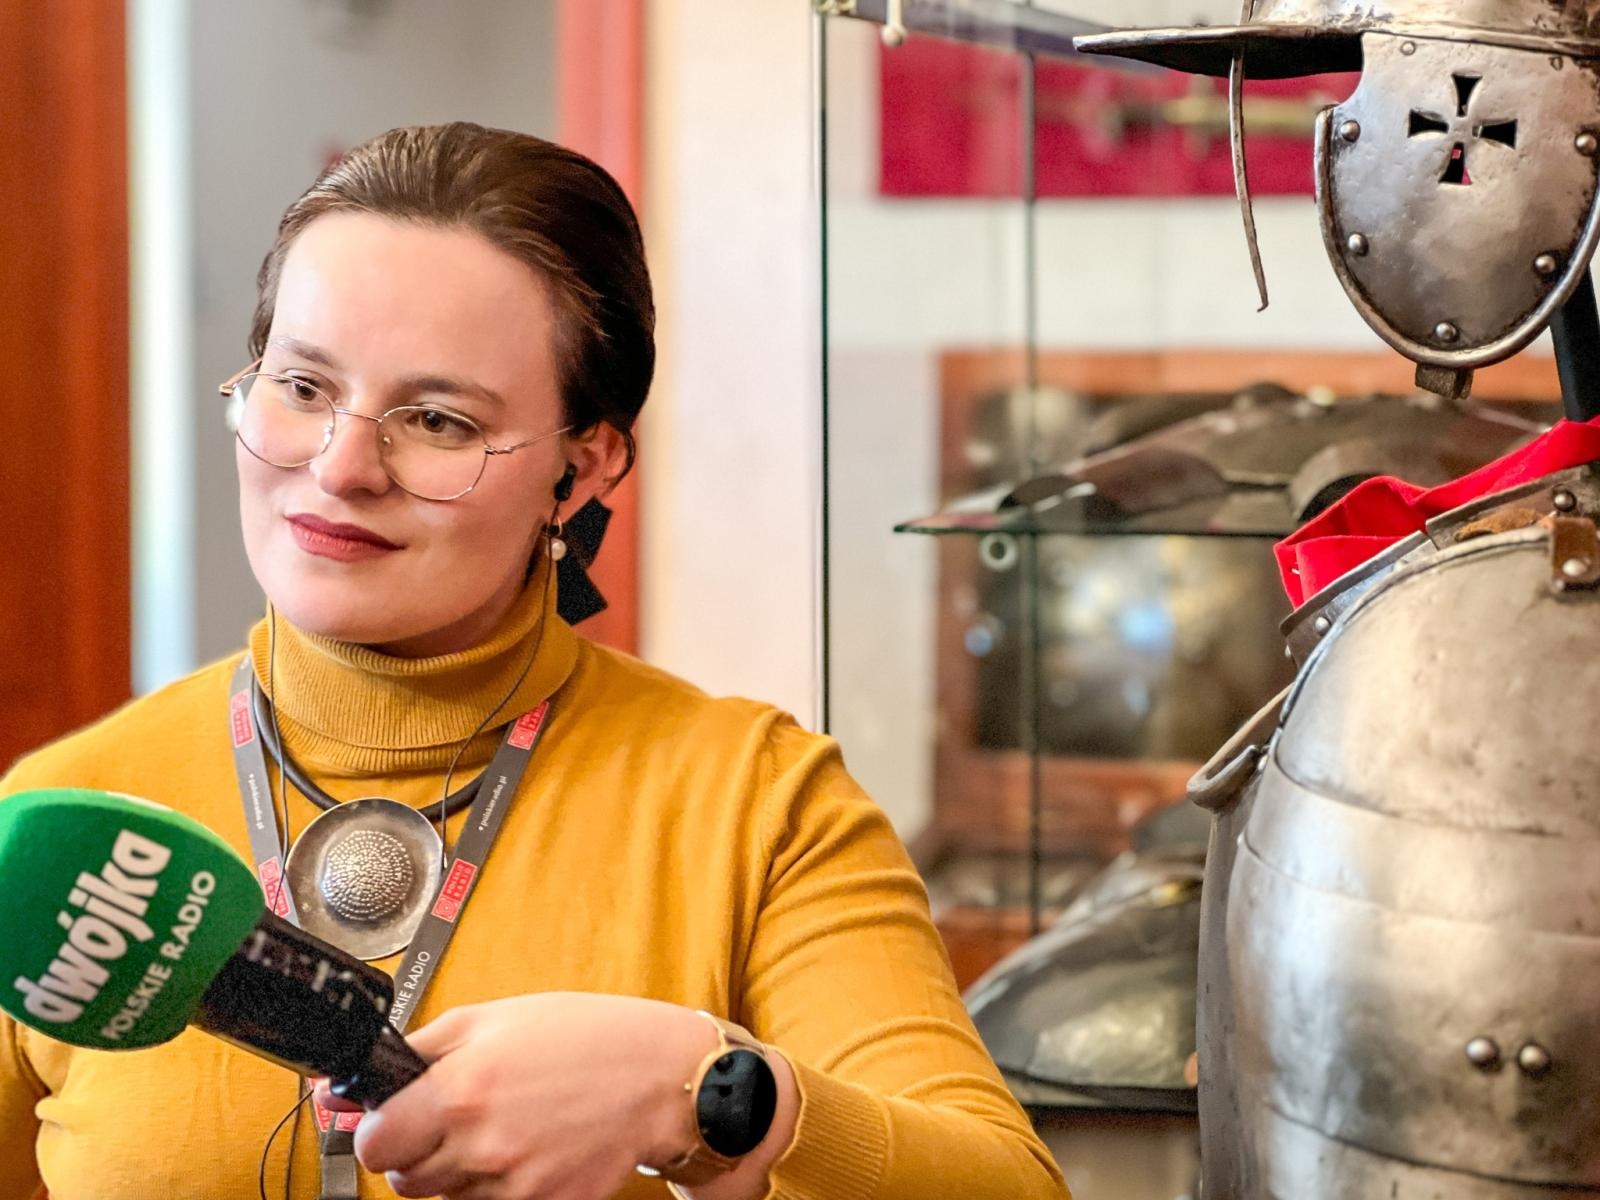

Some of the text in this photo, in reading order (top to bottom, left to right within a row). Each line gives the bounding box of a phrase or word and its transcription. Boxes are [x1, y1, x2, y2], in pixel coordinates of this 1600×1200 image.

[14, 828, 172, 1023] dwójka
[100, 871, 216, 1040] POLSKIE RADIO
[403, 951, 431, 990] RADIO
